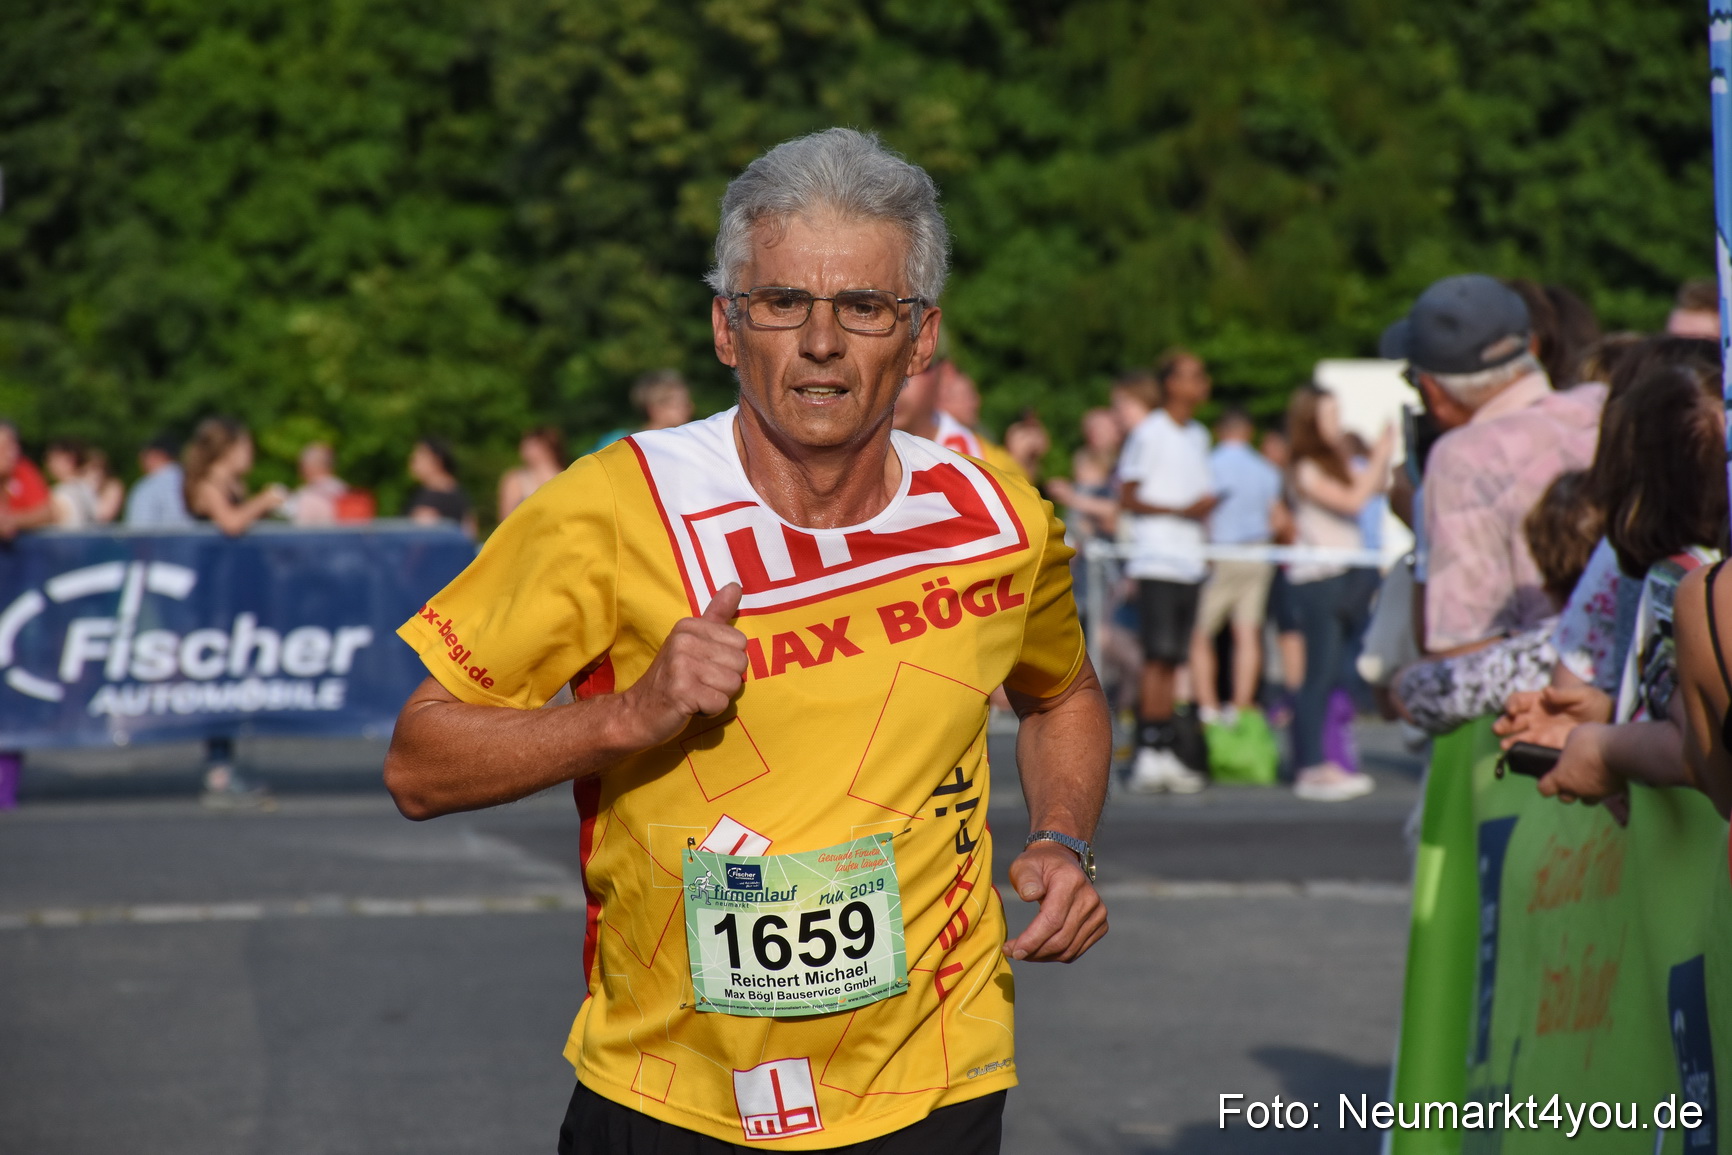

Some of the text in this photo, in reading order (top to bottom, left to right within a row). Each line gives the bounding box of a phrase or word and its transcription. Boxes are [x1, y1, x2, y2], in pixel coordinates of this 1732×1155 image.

[876, 573, 1025, 645] BÖGL
[58, 611, 374, 684] Fischer
[88, 679, 349, 717] AUTOMOBILE
[732, 870, 756, 878] Fischer
[714, 885, 798, 902] firmenlauf
[850, 878, 884, 899] 2019
[713, 901, 876, 971] 1659
[730, 961, 869, 988] Reichert Michael
[724, 975, 877, 1003] Max Bögl Bauservice GmbH
